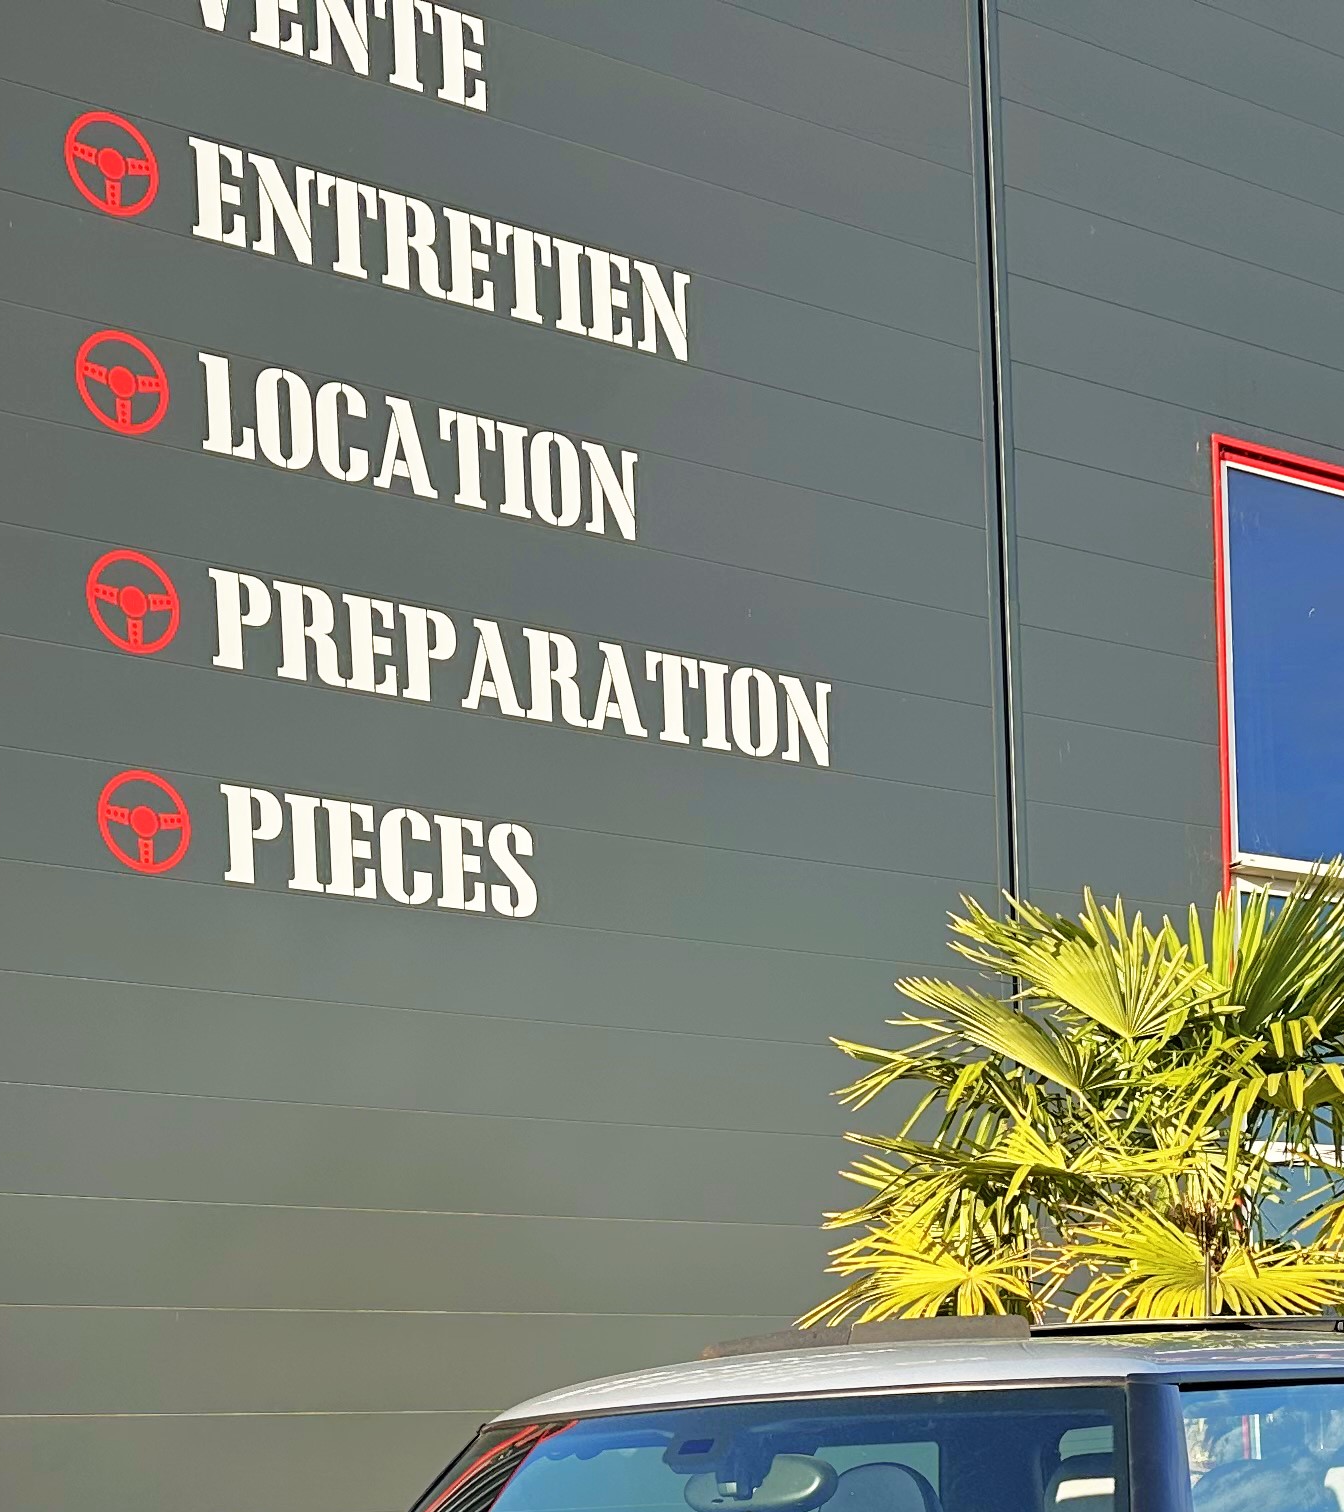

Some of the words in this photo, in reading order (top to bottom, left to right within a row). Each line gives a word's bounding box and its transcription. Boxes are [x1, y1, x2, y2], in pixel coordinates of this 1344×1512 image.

[199, 0, 487, 112] ENTE
[188, 136, 691, 362] ENTRETIEN
[198, 352, 639, 541] LOCATION
[208, 567, 832, 767] PREPARATION
[219, 783, 538, 918] PIECES
